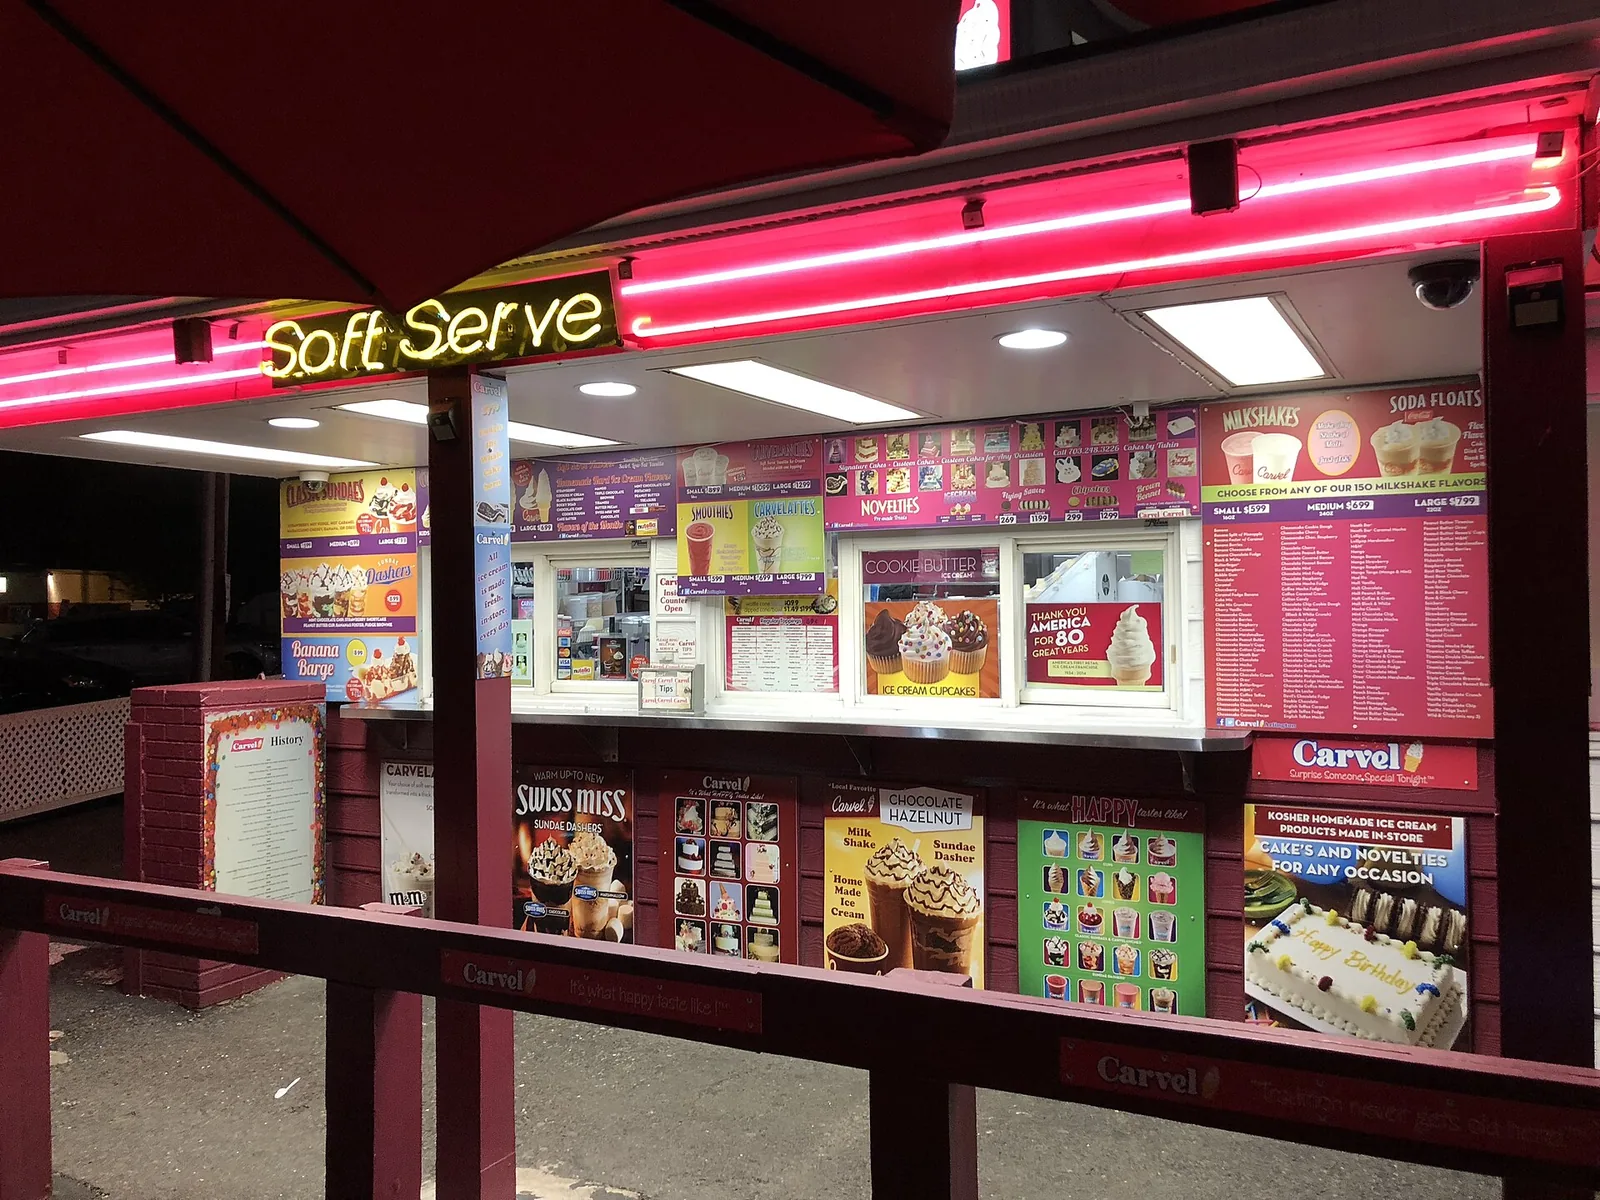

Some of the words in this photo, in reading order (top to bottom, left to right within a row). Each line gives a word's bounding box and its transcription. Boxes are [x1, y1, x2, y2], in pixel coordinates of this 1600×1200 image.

[261, 310, 385, 378] Soft
[399, 293, 603, 360] Serve
[473, 382, 500, 396] Carvel
[1390, 395, 1427, 413] SODA
[1430, 389, 1482, 407] FLOATS
[1223, 406, 1300, 432] MILKSHAKES
[1068, 445, 1120, 455] 703.248.3226
[1146, 443, 1155, 451] by
[985, 455, 994, 463] for
[1257, 466, 1290, 481] Carvel
[1136, 482, 1161, 493] Brown
[1217, 488, 1257, 498] CHOOSE
[1259, 486, 1288, 496] FROM
[1290, 485, 1311, 495] ANY
[1314, 485, 1327, 493] OF
[1330, 484, 1352, 493] OUR
[1354, 483, 1372, 492] 150
[1375, 480, 1436, 491] MILKSHAKE
[1438, 478, 1486, 488] FLAVORS
[691, 505, 733, 522] SMOOTHIES
[754, 500, 815, 517] CARVELATTES
[861, 497, 920, 516] NOVELTIES
[1100, 511, 1118, 519] 1299
[1213, 507, 1242, 515] SMALL
[1307, 503, 1344, 511] MEDIUM
[1415, 498, 1447, 507] LARGE
[477, 534, 504, 546] Carvel
[487, 552, 498, 563] All
[866, 559, 920, 574] COOKIE
[924, 557, 976, 572] BUTTER
[365, 565, 412, 585] Dashers
[478, 572, 488, 583] ice
[488, 563, 508, 577] cream
[481, 586, 488, 595] is
[488, 578, 506, 591] made
[1031, 609, 1064, 622] THANK
[1065, 607, 1087, 617] YOU
[480, 628, 497, 641] every
[498, 621, 509, 632] day
[1029, 616, 1091, 633] AMERICA
[1034, 636, 1054, 646] FOR
[1055, 629, 1084, 646] 80
[292, 640, 339, 658] Banana
[1032, 648, 1060, 657] GREAT
[1061, 645, 1089, 654] YEARS
[297, 659, 334, 681] Barge
[660, 685, 673, 693] Tips
[883, 686, 894, 694] ICE
[897, 686, 927, 695] CREAM
[930, 687, 976, 696] CUPCAKES
[232, 743, 258, 751] Carvel
[271, 735, 304, 747] History
[1293, 739, 1401, 770] Carvel
[534, 770, 558, 781] WARM
[560, 771, 570, 779] UP
[573, 771, 583, 781] TO
[585, 773, 605, 784] NEW
[702, 776, 741, 791] Carvel
[1289, 769, 1322, 780] Surprise
[1324, 771, 1362, 782] Someone
[1364, 772, 1395, 784] Special
[849, 784, 876, 792] Favorite
[516, 784, 572, 816] SWISS
[889, 794, 962, 809] CHOCOLATE
[889, 809, 962, 826] HAZELNUT
[1033, 799, 1046, 809] It's
[1047, 802, 1070, 811] what
[1071, 795, 1139, 827] HAPPY
[1137, 807, 1162, 818] tastes
[1164, 809, 1188, 820] like!
[534, 819, 565, 831] SUNDAE
[566, 822, 603, 833] DASHERS
[1268, 811, 1310, 823] KOSHER
[1312, 814, 1373, 828] HOMEMADE
[1376, 818, 1394, 829] ICE
[1397, 819, 1437, 831] CREAM
[847, 827, 872, 838] Milk
[1280, 824, 1336, 837] PRODUCTS
[1338, 827, 1370, 839] MADE
[1372, 830, 1424, 843] IN-STORE
[843, 838, 876, 849] Shake
[933, 840, 976, 852] Sundae
[934, 851, 975, 863] Dasher
[1259, 841, 1314, 856] CAKE'S
[1317, 845, 1352, 860] AND
[1356, 848, 1448, 868] NOVELTIES
[833, 874, 863, 886] Home
[1271, 859, 1302, 874] FOR
[1306, 864, 1341, 878] ANY
[1344, 866, 1434, 886] OCCASION
[834, 886, 861, 898] Made
[840, 897, 855, 908] Ice
[830, 907, 865, 919] Cream
[1296, 926, 1342, 961] Happy
[1342, 949, 1416, 995] Birthday
[463, 962, 524, 991] Carvel
[619, 986, 657, 1012] happy
[1097, 1055, 1198, 1096] Carvel
